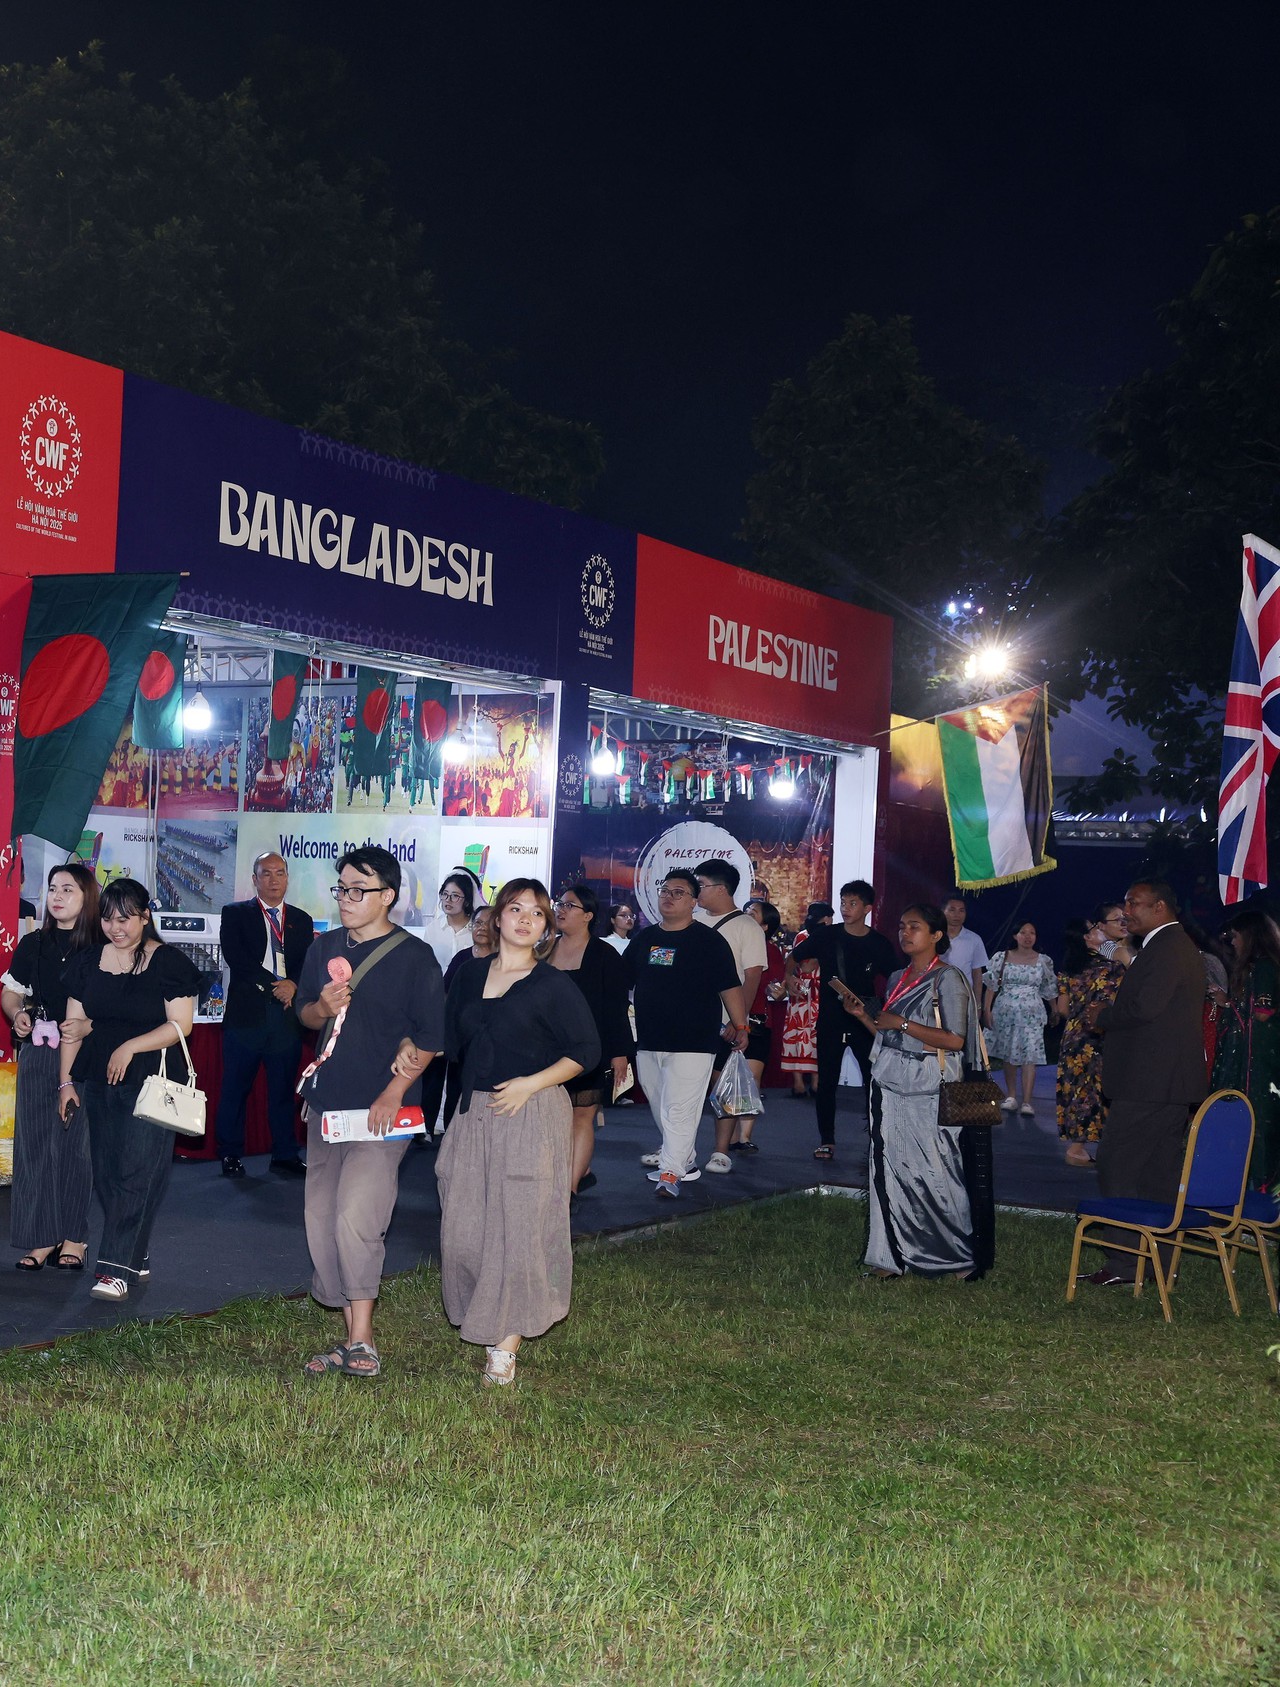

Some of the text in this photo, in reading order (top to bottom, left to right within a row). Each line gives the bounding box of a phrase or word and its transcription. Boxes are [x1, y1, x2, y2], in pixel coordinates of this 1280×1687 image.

[35, 436, 69, 471] CWF
[49, 519, 63, 531] 2025
[219, 480, 495, 606] BANGLADESH
[589, 584, 608, 608] CWF
[707, 614, 839, 692] PALESTINE
[565, 771, 578, 784] CWF
[279, 834, 338, 859] Welcome
[664, 848, 734, 859] PALESTINE
